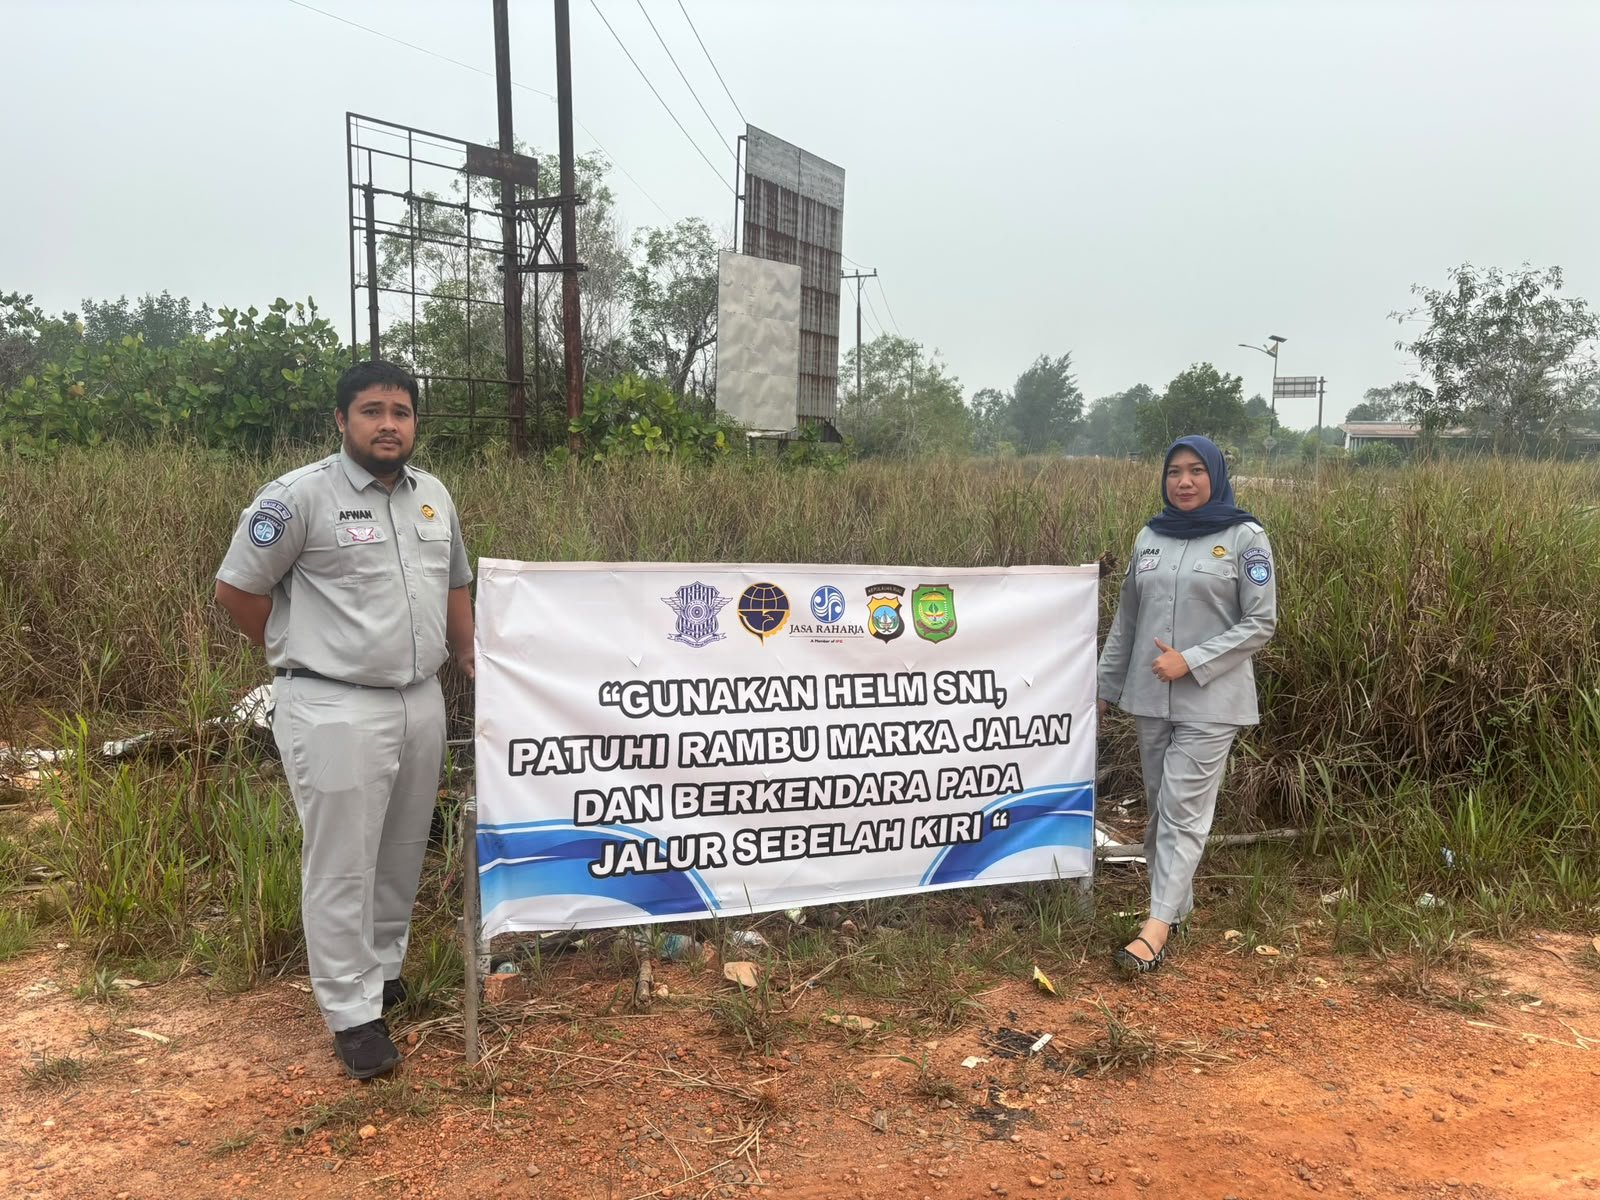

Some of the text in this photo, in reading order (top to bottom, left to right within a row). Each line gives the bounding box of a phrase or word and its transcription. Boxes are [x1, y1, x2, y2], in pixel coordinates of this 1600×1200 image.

[339, 510, 373, 521] AFWAN
[789, 624, 865, 635] JASA RAHARJA
[600, 669, 1007, 719] “GUNAKAN HELM SNI,
[508, 713, 1072, 777] PATUHI RAMBU MARKA JALAN
[573, 762, 1023, 826] DAN BERKENDARA PADA
[590, 833, 726, 878] JALUR
[732, 818, 904, 864] SEBELAH
[912, 811, 985, 850] KIRI
